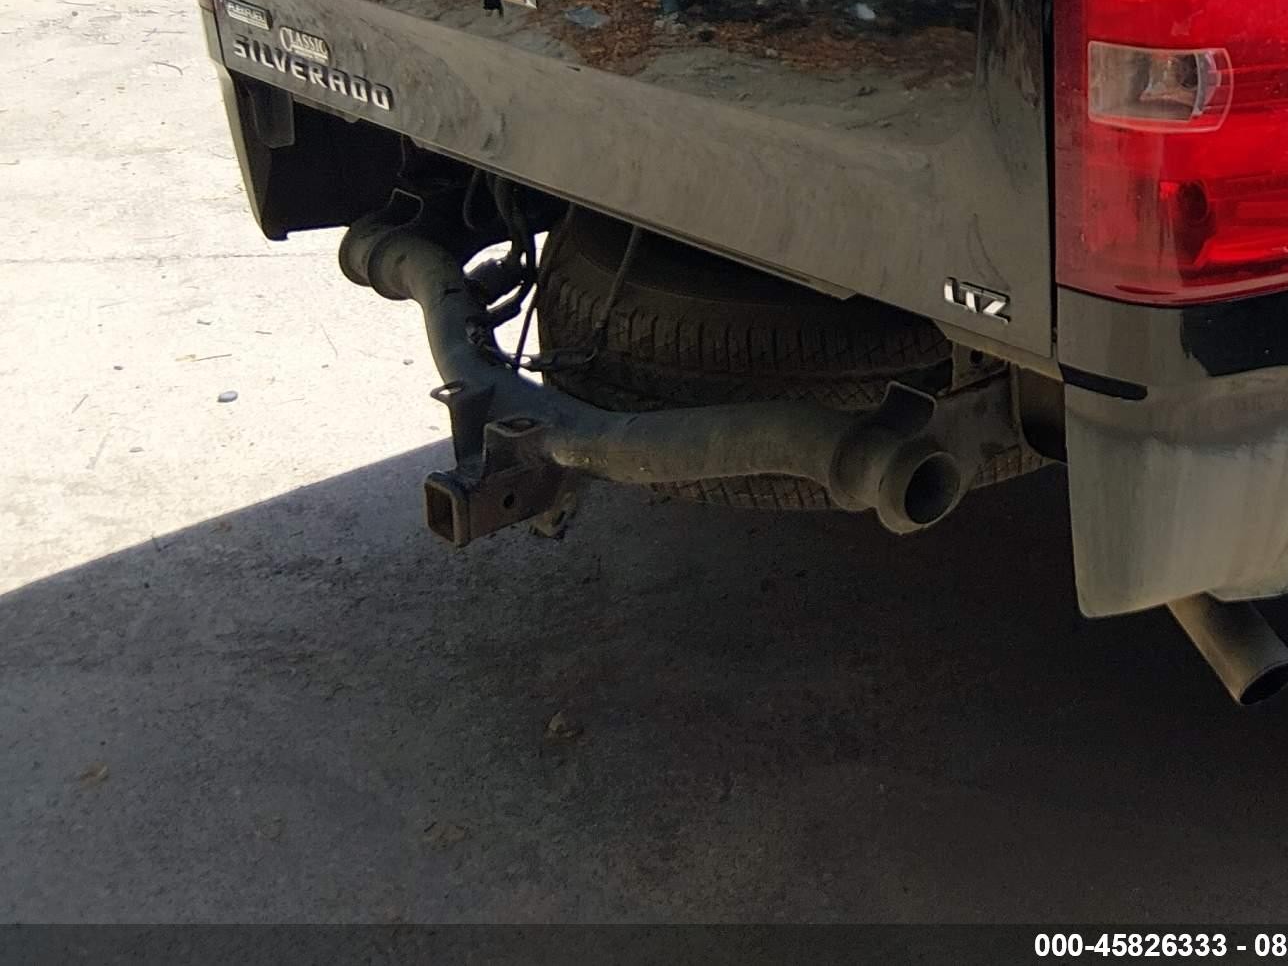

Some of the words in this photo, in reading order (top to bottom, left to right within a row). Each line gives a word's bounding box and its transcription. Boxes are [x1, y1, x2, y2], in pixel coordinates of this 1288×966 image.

[279, 27, 330, 55] CLASSIC
[233, 36, 393, 111] SILVERADO
[943, 277, 1010, 325] LTZ
